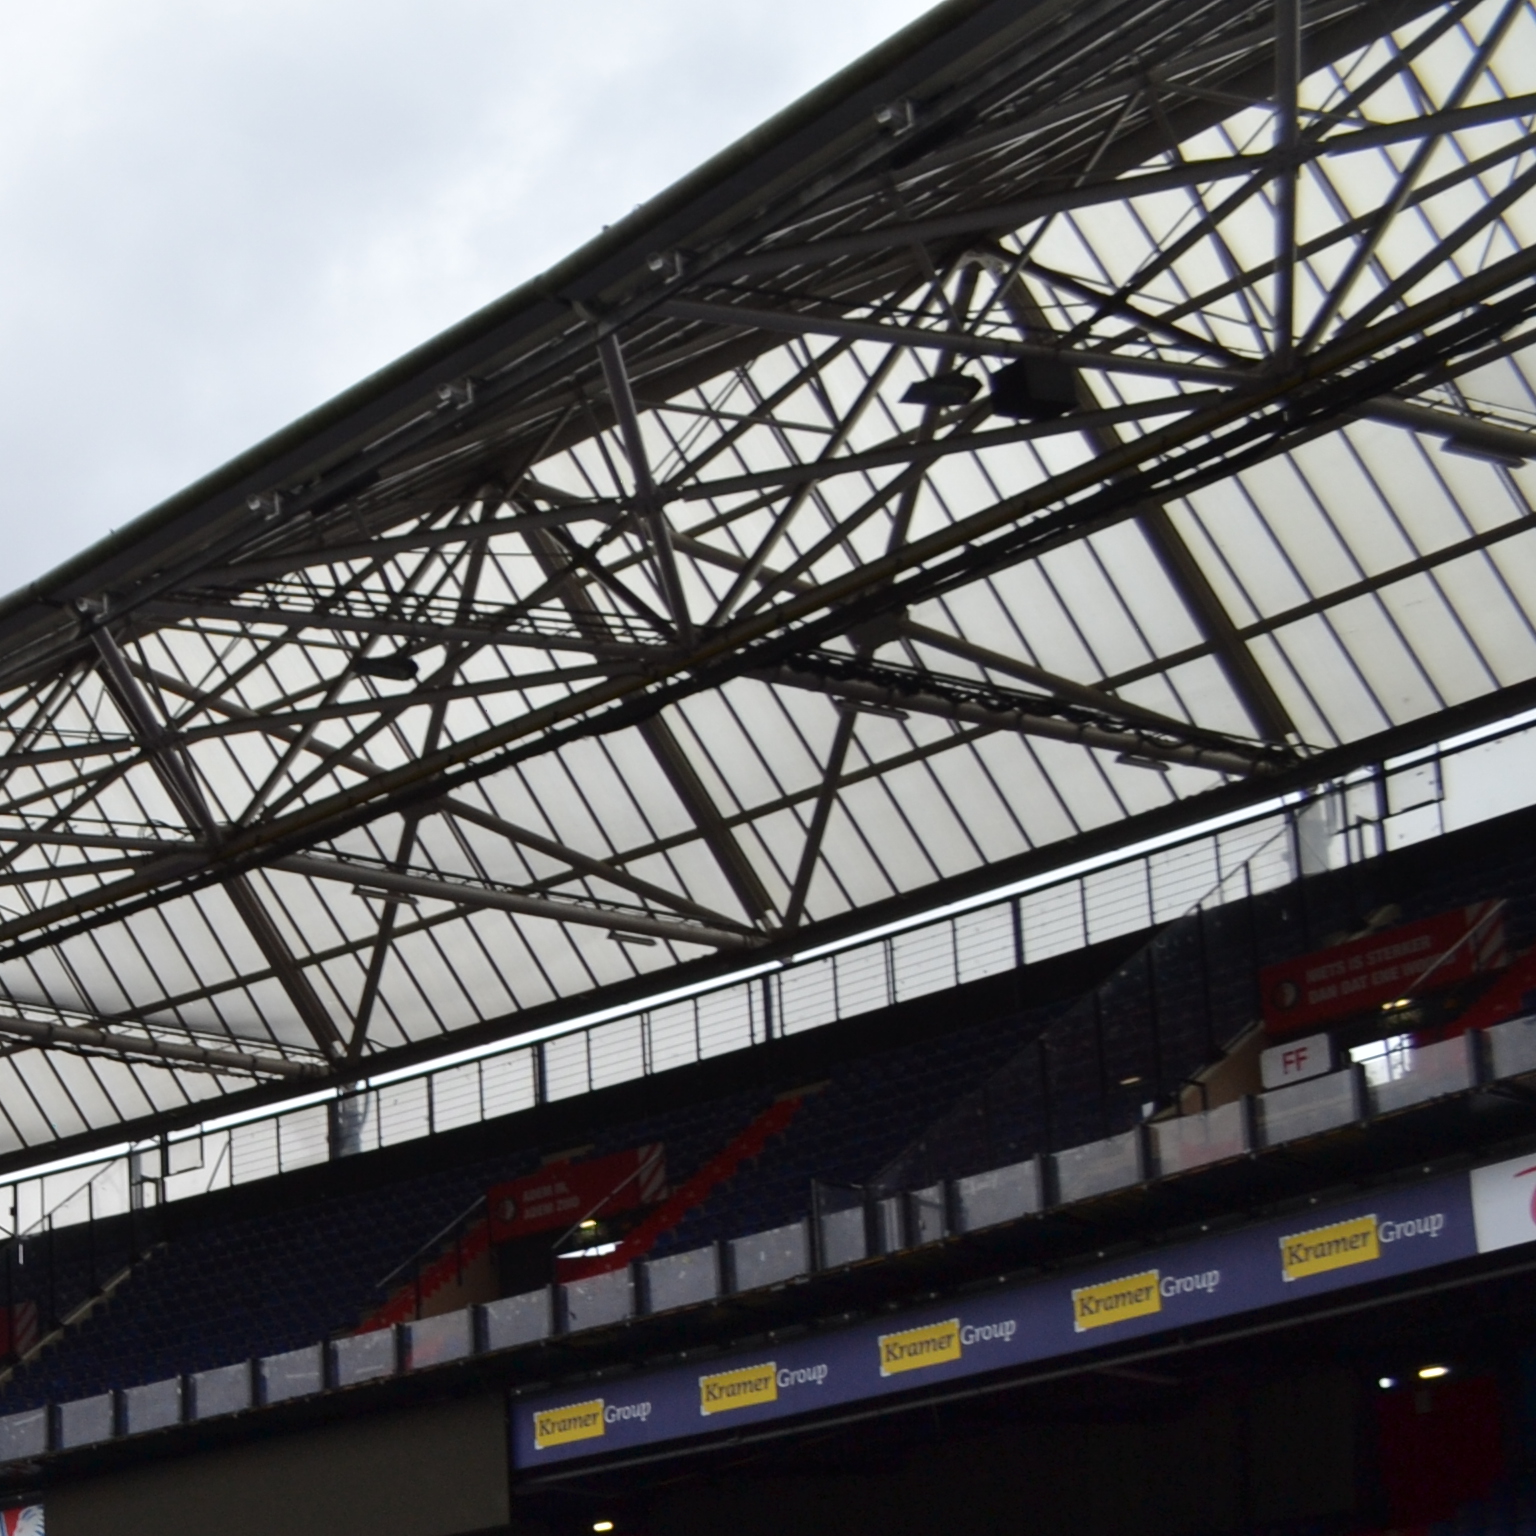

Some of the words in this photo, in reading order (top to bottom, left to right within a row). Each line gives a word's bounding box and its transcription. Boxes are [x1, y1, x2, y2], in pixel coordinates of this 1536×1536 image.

[1282, 1047, 1309, 1075] FF
[1286, 1228, 1372, 1266] Kramer
[1377, 1212, 1444, 1244] Group
[1079, 1283, 1157, 1319] Kramer
[1160, 1269, 1220, 1299] Group
[885, 1330, 956, 1364] Kramer
[960, 1318, 1017, 1346] Group
[705, 1372, 774, 1403] Kramer
[777, 1362, 828, 1388] Group
[538, 1410, 602, 1438] Kramer
[604, 1399, 651, 1424] Group
